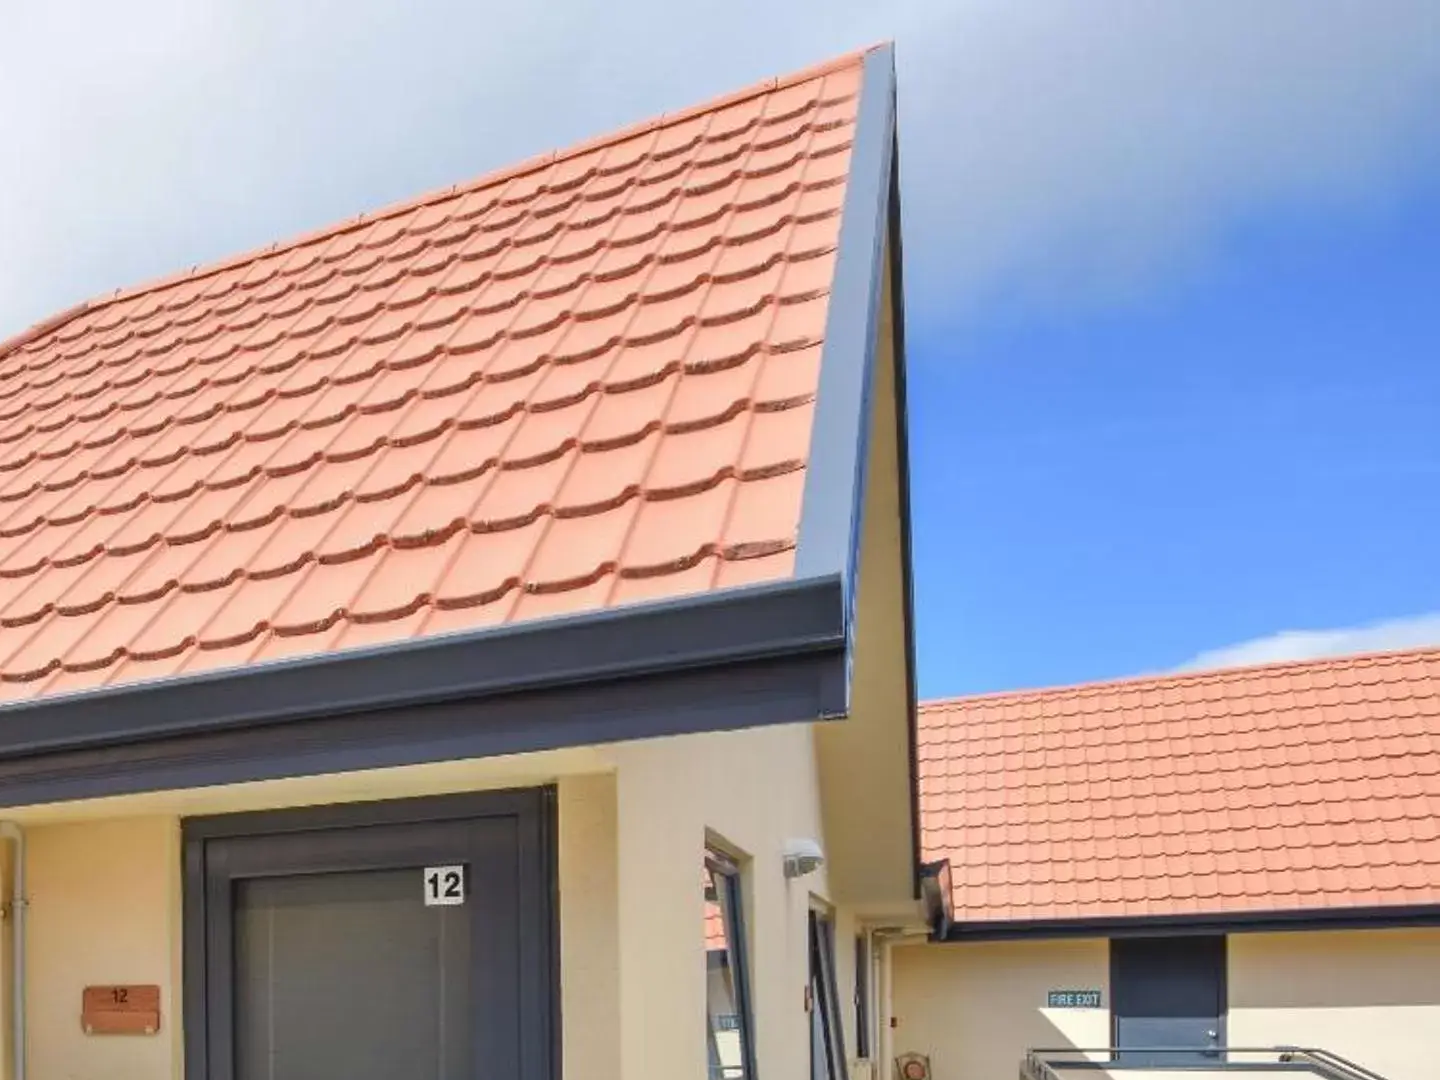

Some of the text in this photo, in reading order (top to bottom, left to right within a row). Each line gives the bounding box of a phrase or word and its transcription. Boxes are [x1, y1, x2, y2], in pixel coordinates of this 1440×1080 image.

[428, 872, 461, 898] 12
[111, 988, 128, 1003] 12
[1050, 994, 1098, 1005] FIRE EXIT
